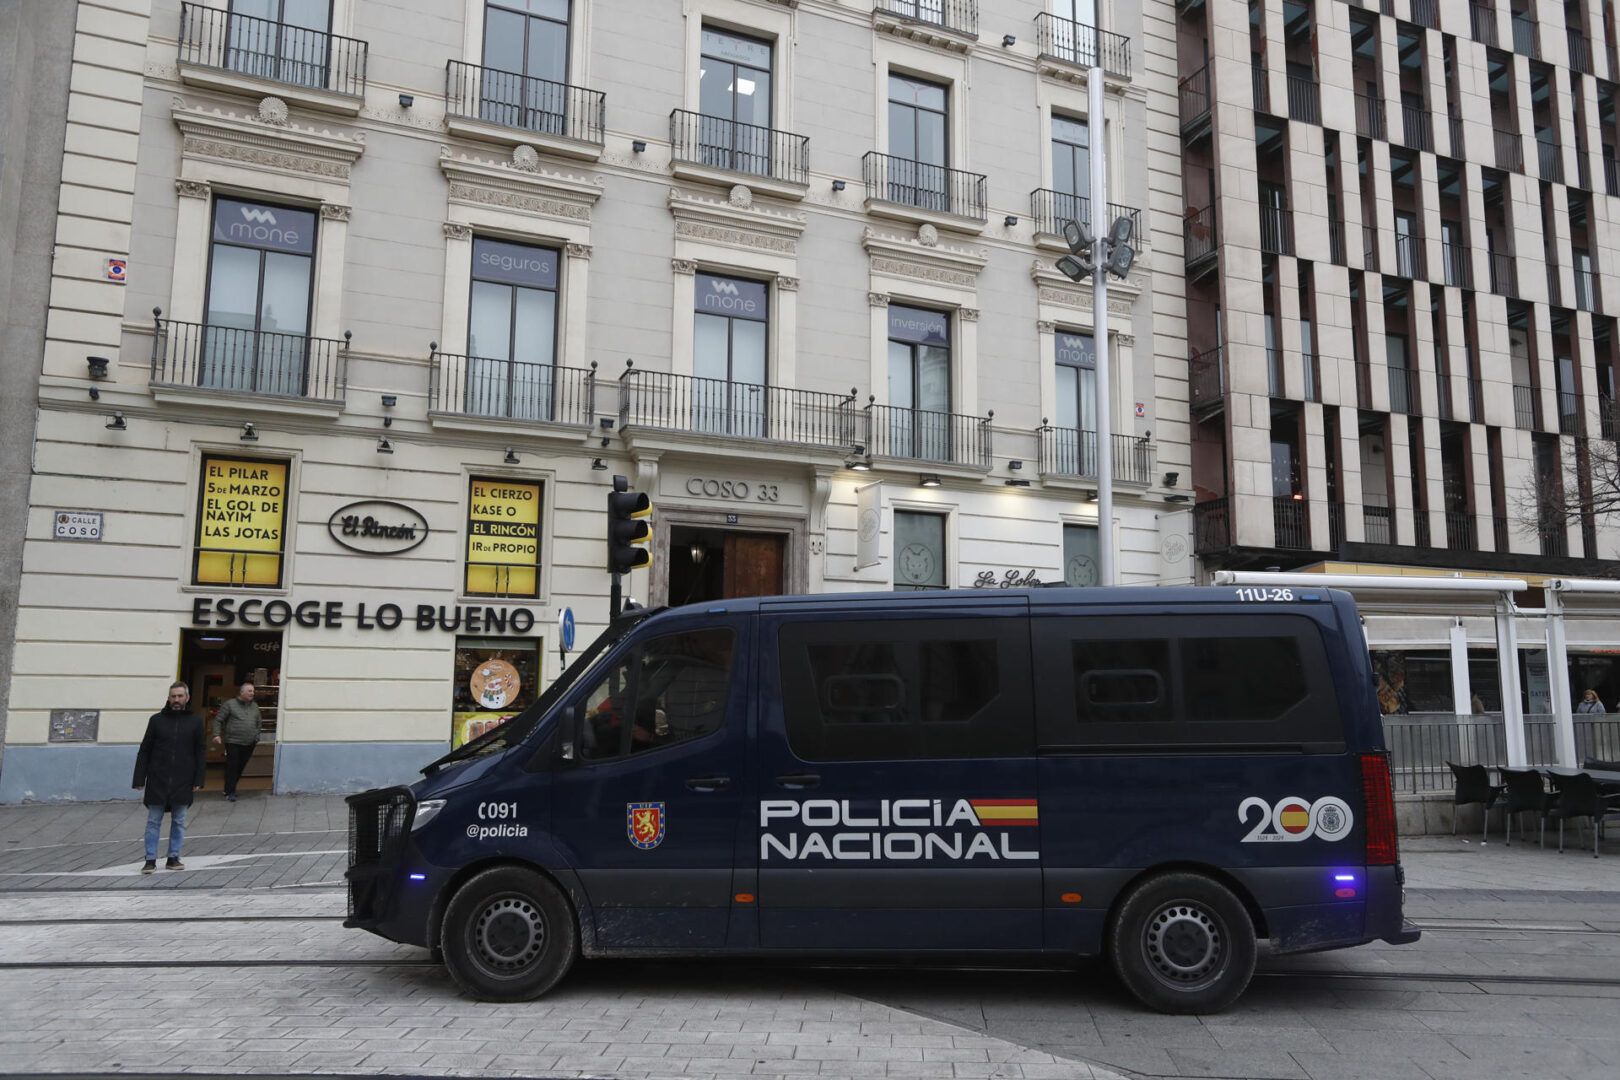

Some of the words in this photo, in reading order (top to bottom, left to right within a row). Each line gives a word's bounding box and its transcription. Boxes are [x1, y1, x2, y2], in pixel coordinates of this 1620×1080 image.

[480, 252, 550, 273] seguros
[209, 466, 224, 478] EL
[229, 467, 269, 481] PILAR
[229, 484, 281, 497] MARZO
[474, 487, 486, 498] EL
[490, 488, 533, 501] CIERZO
[686, 478, 749, 499] COSO
[757, 484, 778, 502] 33
[207, 498, 222, 510] EL
[226, 500, 256, 512] GOL
[261, 502, 279, 513] DE
[473, 504, 503, 516] KASE
[71, 517, 97, 525] CALLE
[206, 510, 252, 523] NAYIM
[58, 526, 98, 536] COSO
[204, 525, 231, 537] LAS
[234, 527, 279, 540] JOTAS
[341, 515, 359, 537] El
[361, 516, 416, 540] Rincón
[473, 523, 487, 535] EL
[490, 523, 536, 537] RINCÓN
[472, 542, 483, 552] IR
[492, 543, 536, 555] PROPIO
[1235, 588, 1294, 602] 11U-26
[192, 598, 343, 628] ESCOGE
[357, 602, 403, 630] LO
[415, 604, 535, 633] BUENO
[487, 802, 517, 819] 091
[1238, 796, 1354, 842] 200
[466, 824, 528, 840] @policia
[760, 832, 1040, 860] NACIONAL
